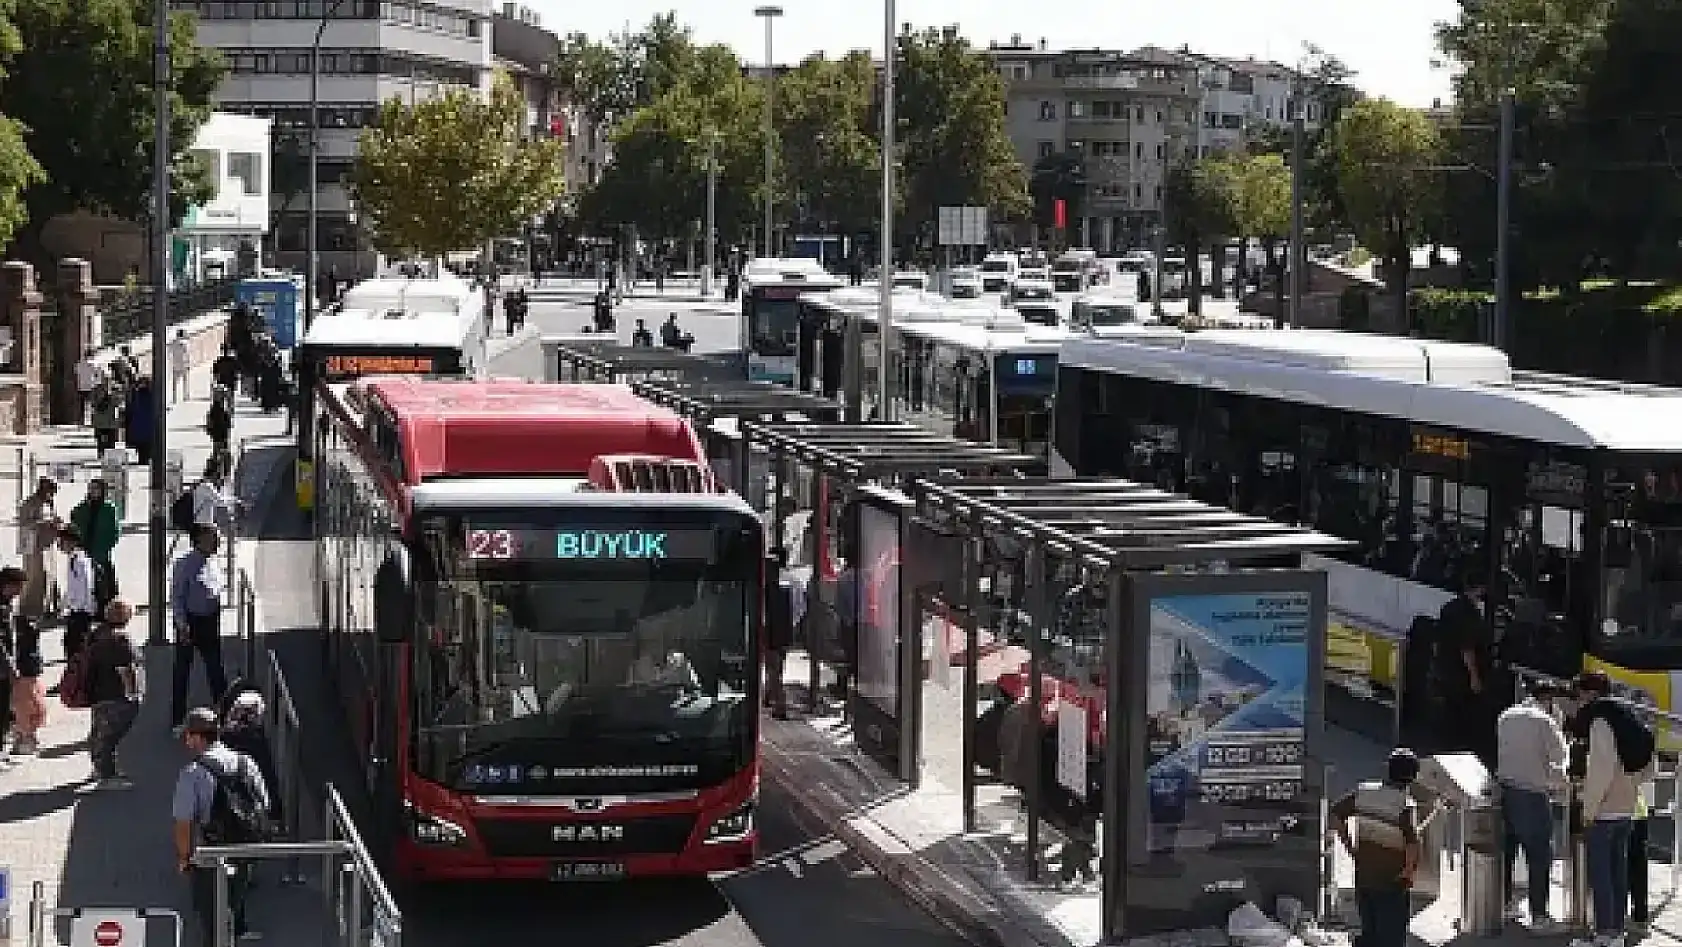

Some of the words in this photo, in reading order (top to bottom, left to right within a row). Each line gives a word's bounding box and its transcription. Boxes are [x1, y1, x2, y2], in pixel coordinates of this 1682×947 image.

[470, 530, 511, 558] 23
[557, 530, 667, 558] BÜYÜK
[553, 826, 623, 841] MAN
